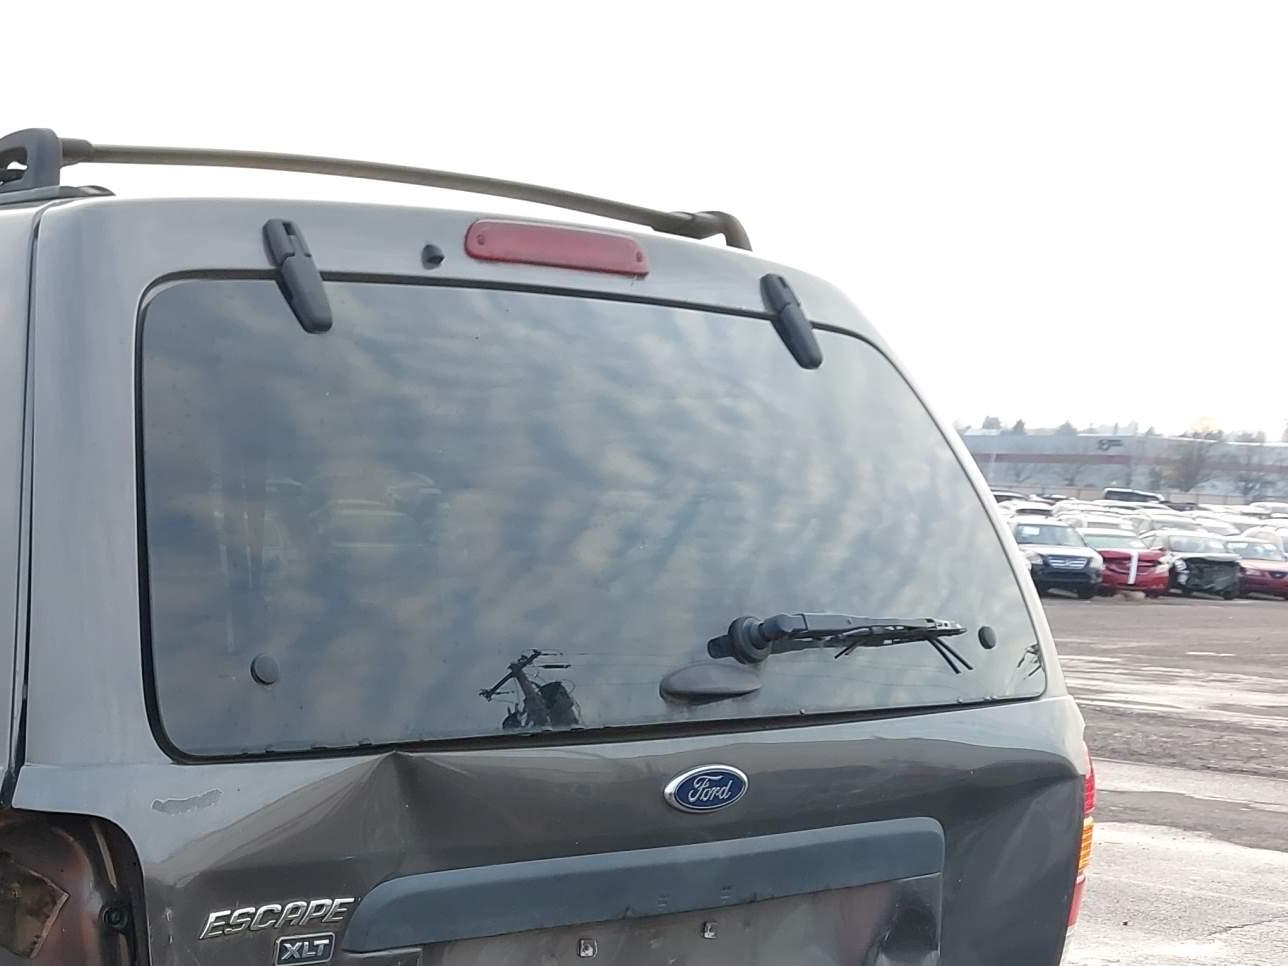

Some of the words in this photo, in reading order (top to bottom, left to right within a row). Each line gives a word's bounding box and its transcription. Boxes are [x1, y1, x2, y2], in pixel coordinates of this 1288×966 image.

[688, 775, 734, 803] Ford
[199, 897, 355, 940] ESCAPE
[281, 939, 330, 960] XLT
